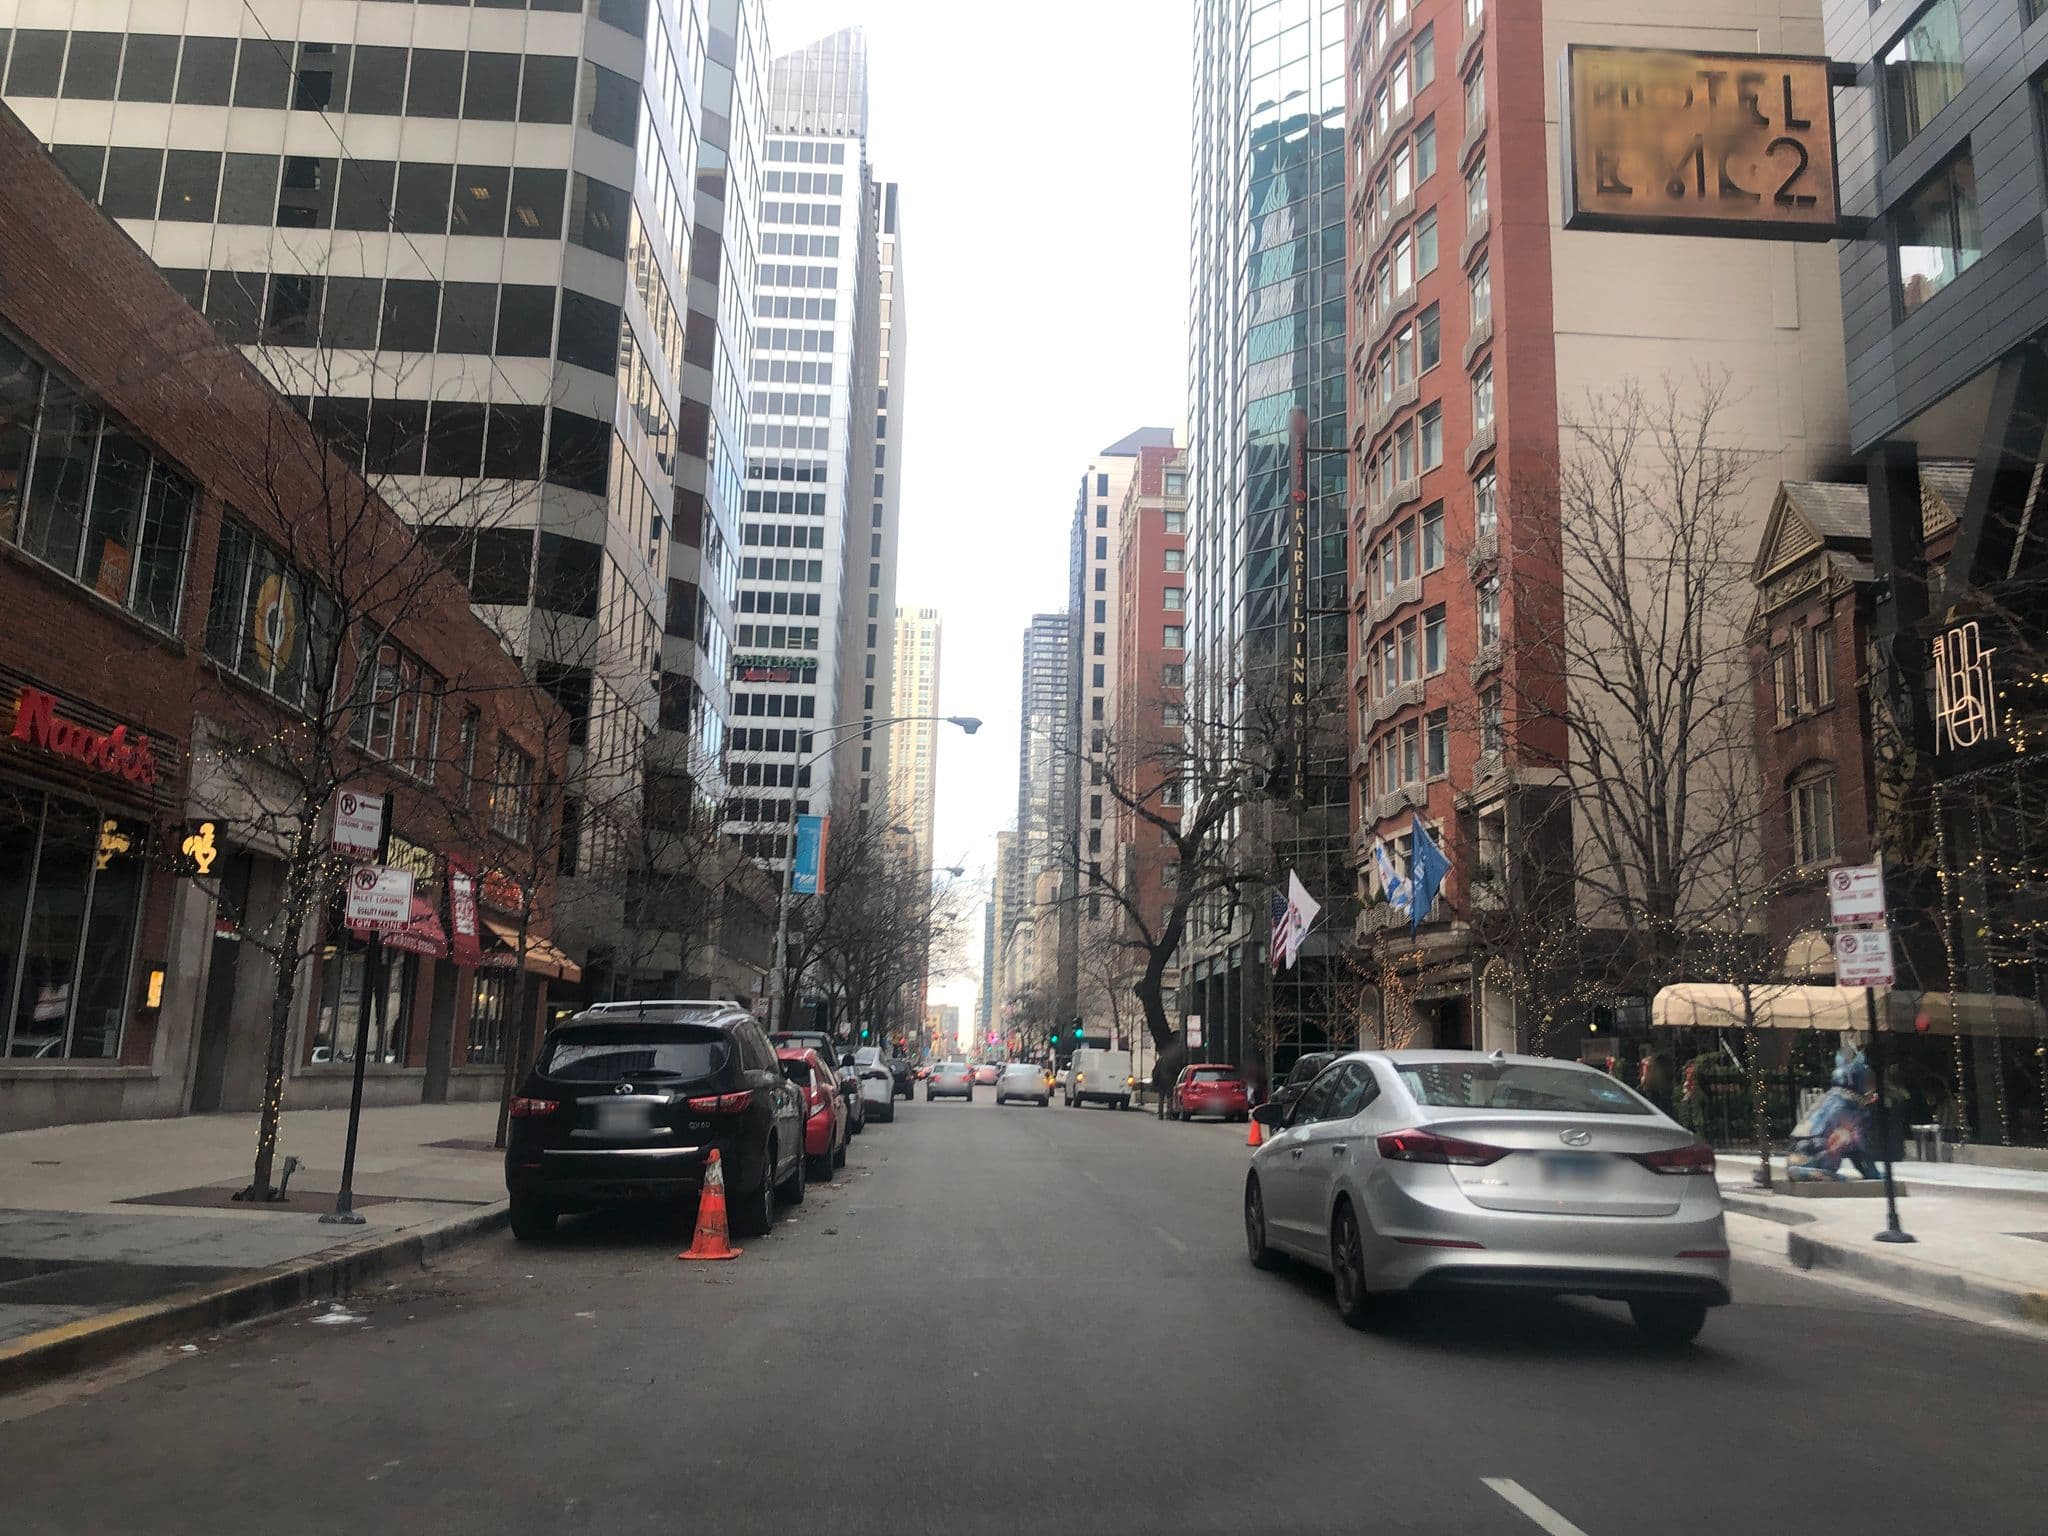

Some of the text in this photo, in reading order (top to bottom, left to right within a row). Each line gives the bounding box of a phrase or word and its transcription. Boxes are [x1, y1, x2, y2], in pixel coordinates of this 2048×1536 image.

[1292, 508, 1306, 801] FAIRFIELD INN & SUITES
[732, 655, 818, 668] OURTYARD
[352, 917, 401, 930] TOW ZONE
